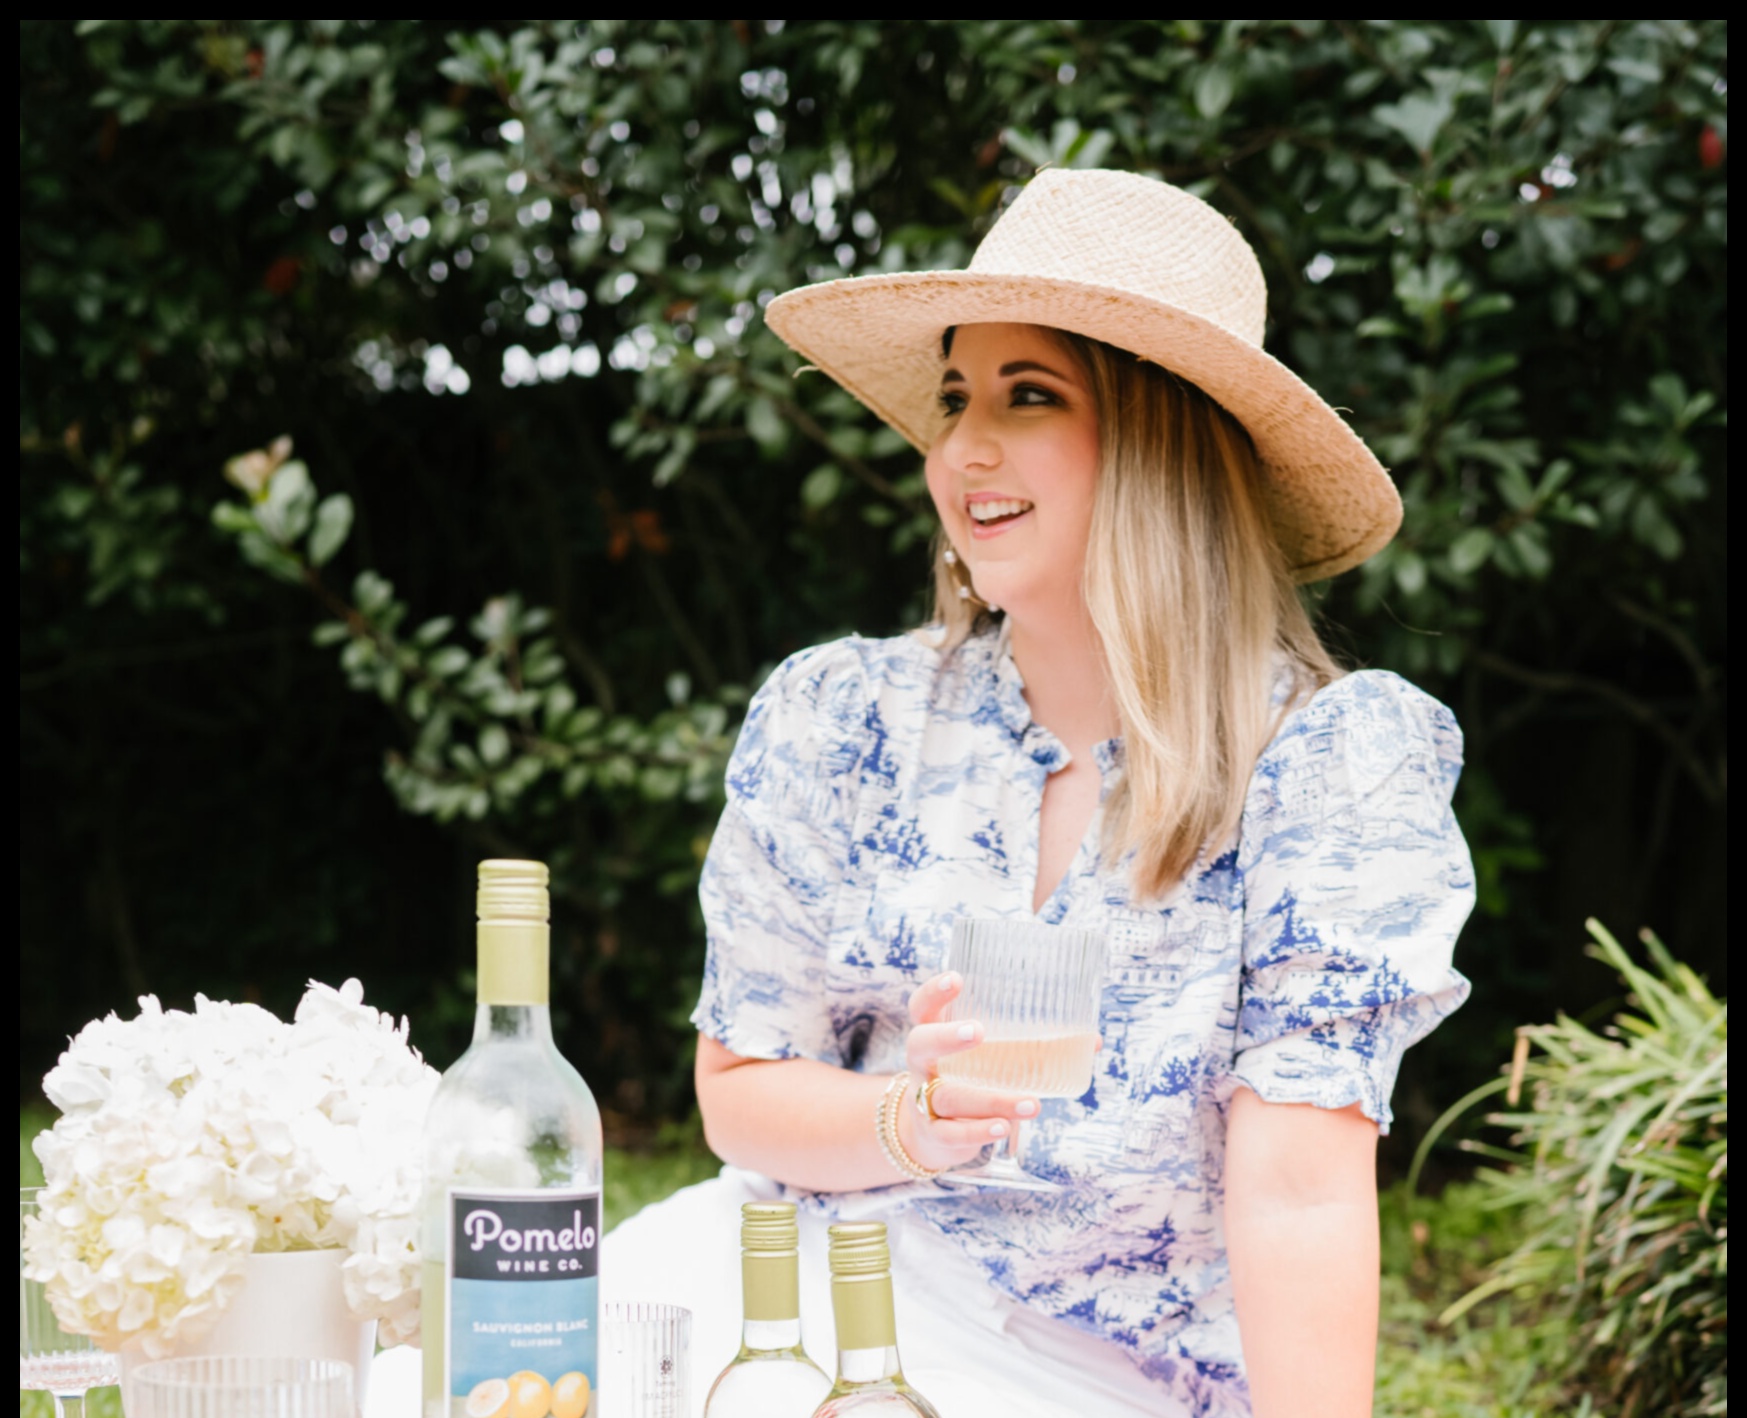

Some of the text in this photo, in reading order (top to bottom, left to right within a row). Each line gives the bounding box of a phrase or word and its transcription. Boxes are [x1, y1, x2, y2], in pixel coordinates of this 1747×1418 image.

[464, 1209, 595, 1253] Pomelo
[496, 1258, 583, 1273] WINE CO.
[472, 1318, 589, 1334] SAUVIGNON BLANC
[509, 1337, 563, 1348] CALIFORNIA
